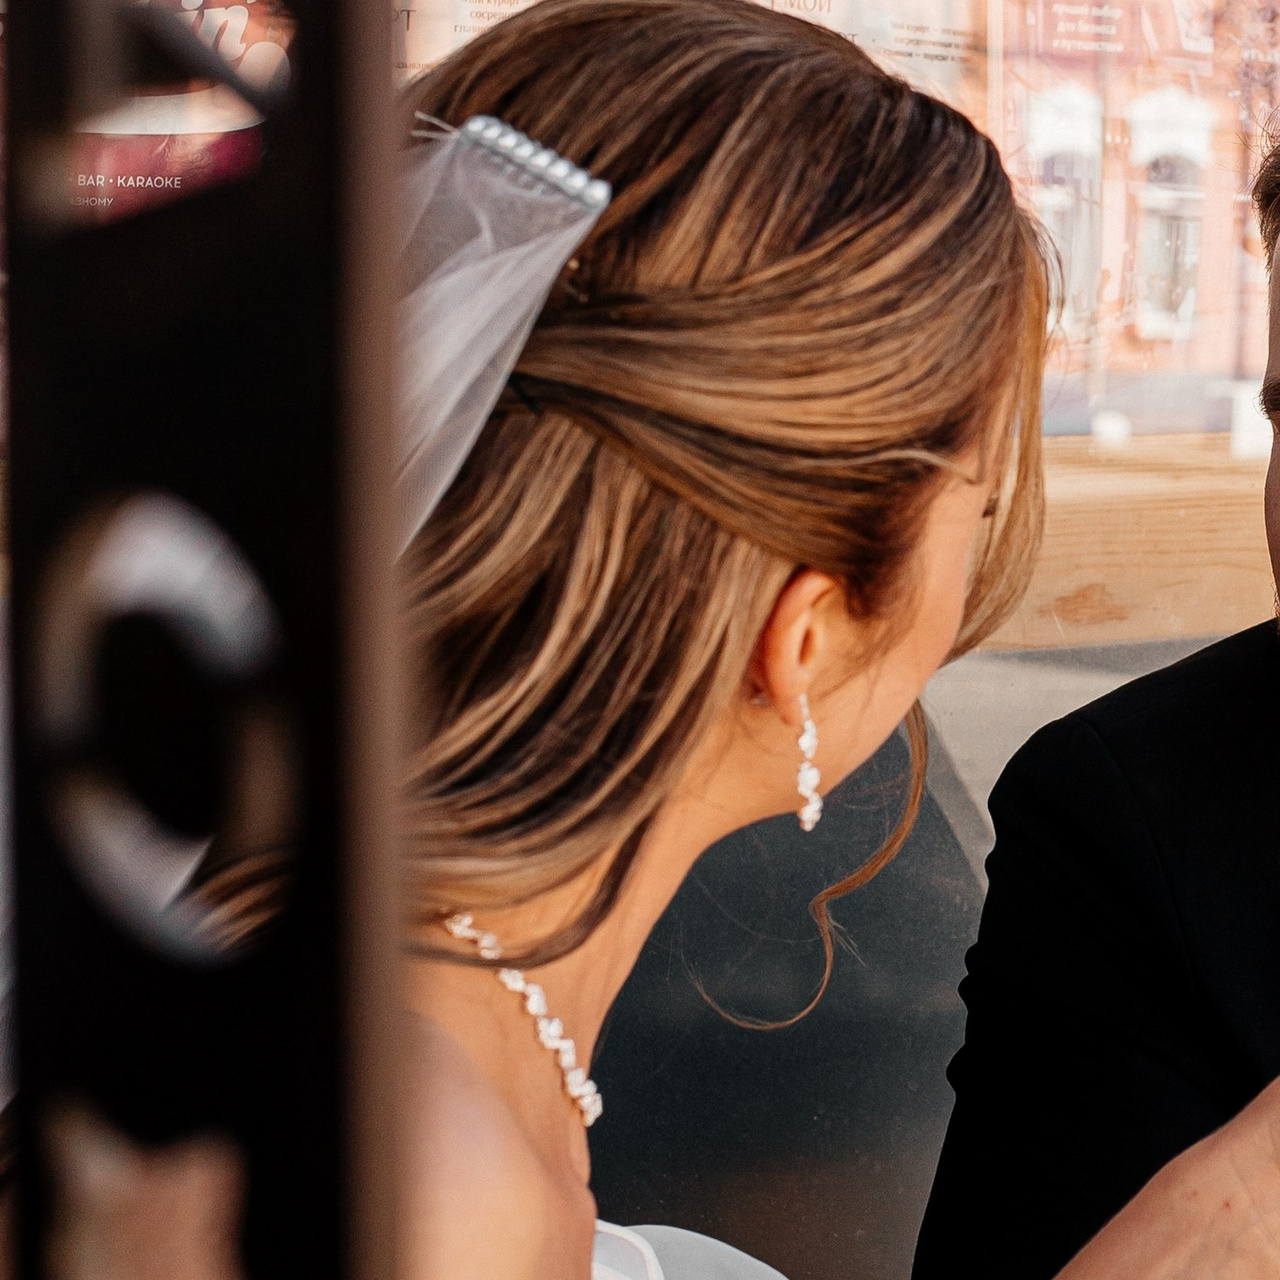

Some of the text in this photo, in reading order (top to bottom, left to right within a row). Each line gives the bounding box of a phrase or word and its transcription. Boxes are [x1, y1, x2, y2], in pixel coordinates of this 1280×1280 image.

[77, 174, 182, 189] BAR KARAOKE
[72, 196, 114, 207] ЗНОМУ
